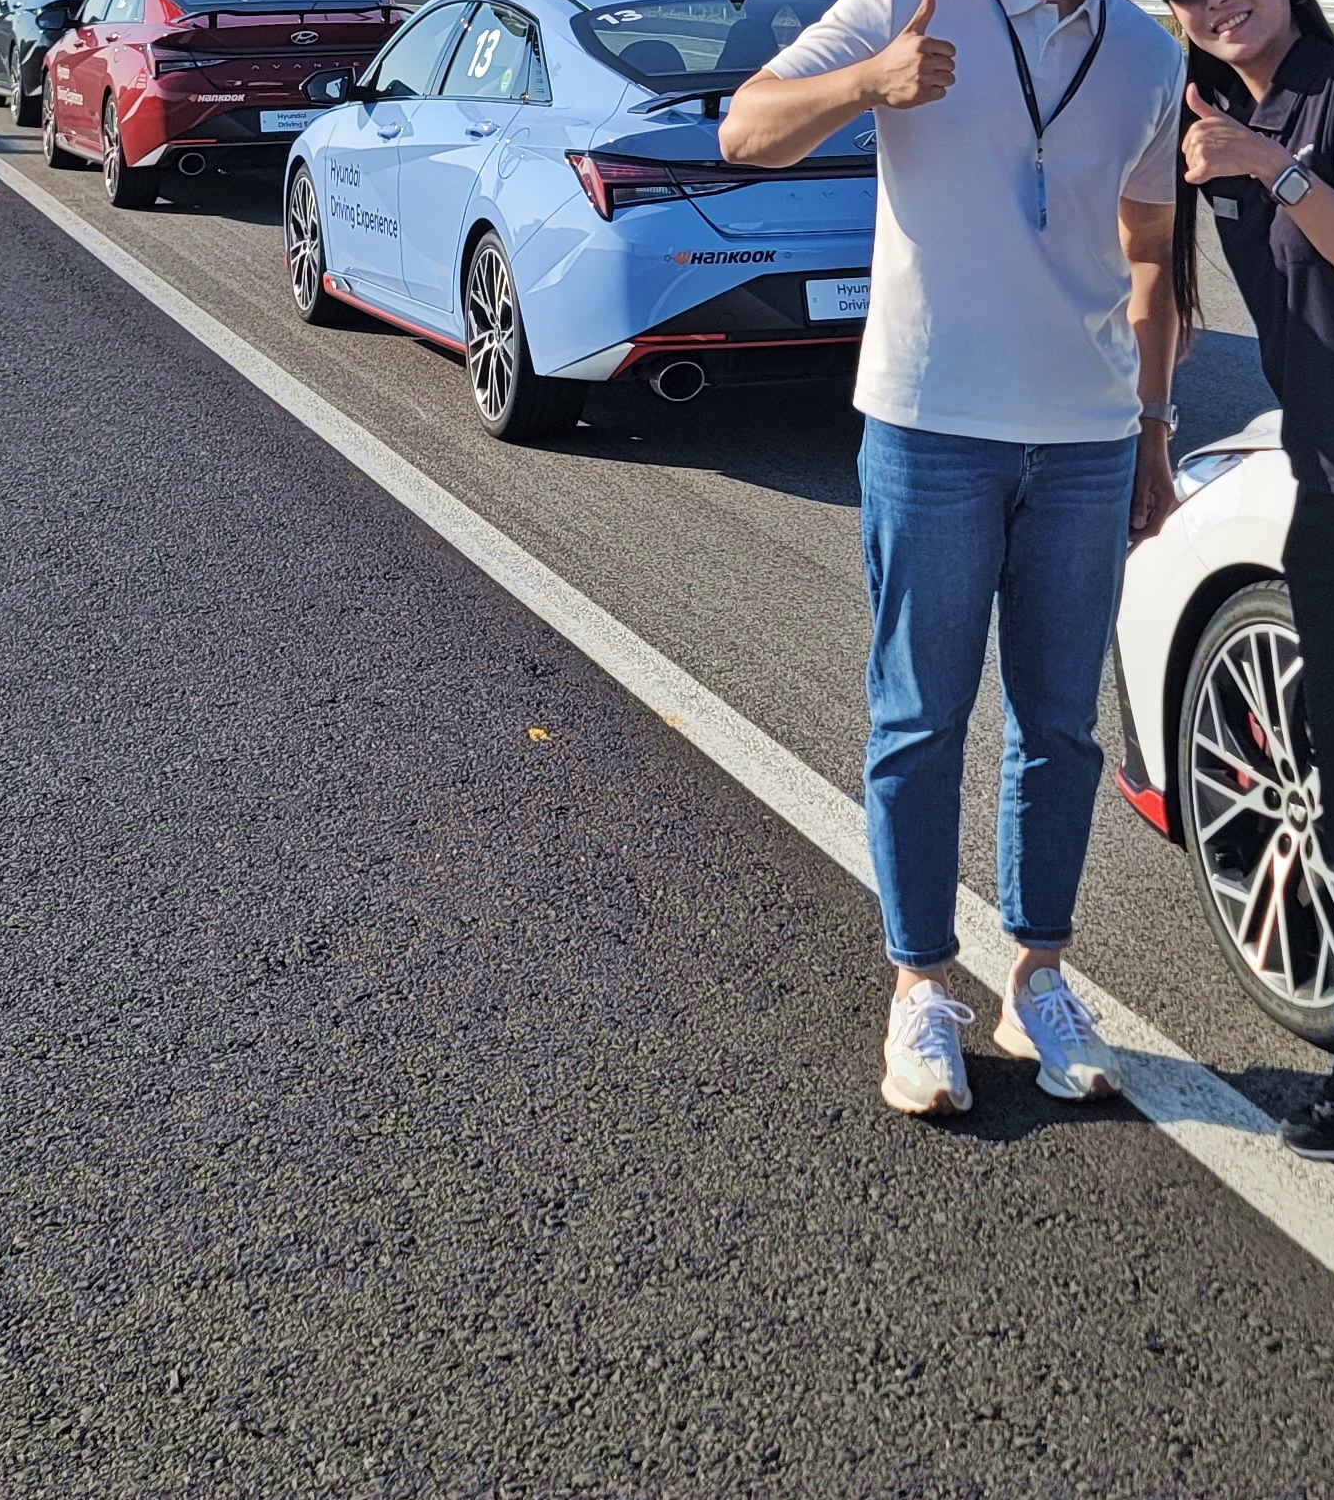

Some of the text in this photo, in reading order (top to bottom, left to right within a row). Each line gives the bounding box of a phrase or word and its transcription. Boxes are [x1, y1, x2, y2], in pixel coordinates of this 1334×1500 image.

[597, 10, 643, 25] 13
[467, 29, 501, 78] 13
[251, 60, 360, 70] AVANTE
[330, 158, 361, 187] Hyundai
[330, 194, 398, 238] Driving Experience
[837, 283, 869, 296] Hyun
[839, 299, 867, 311] Drivi
